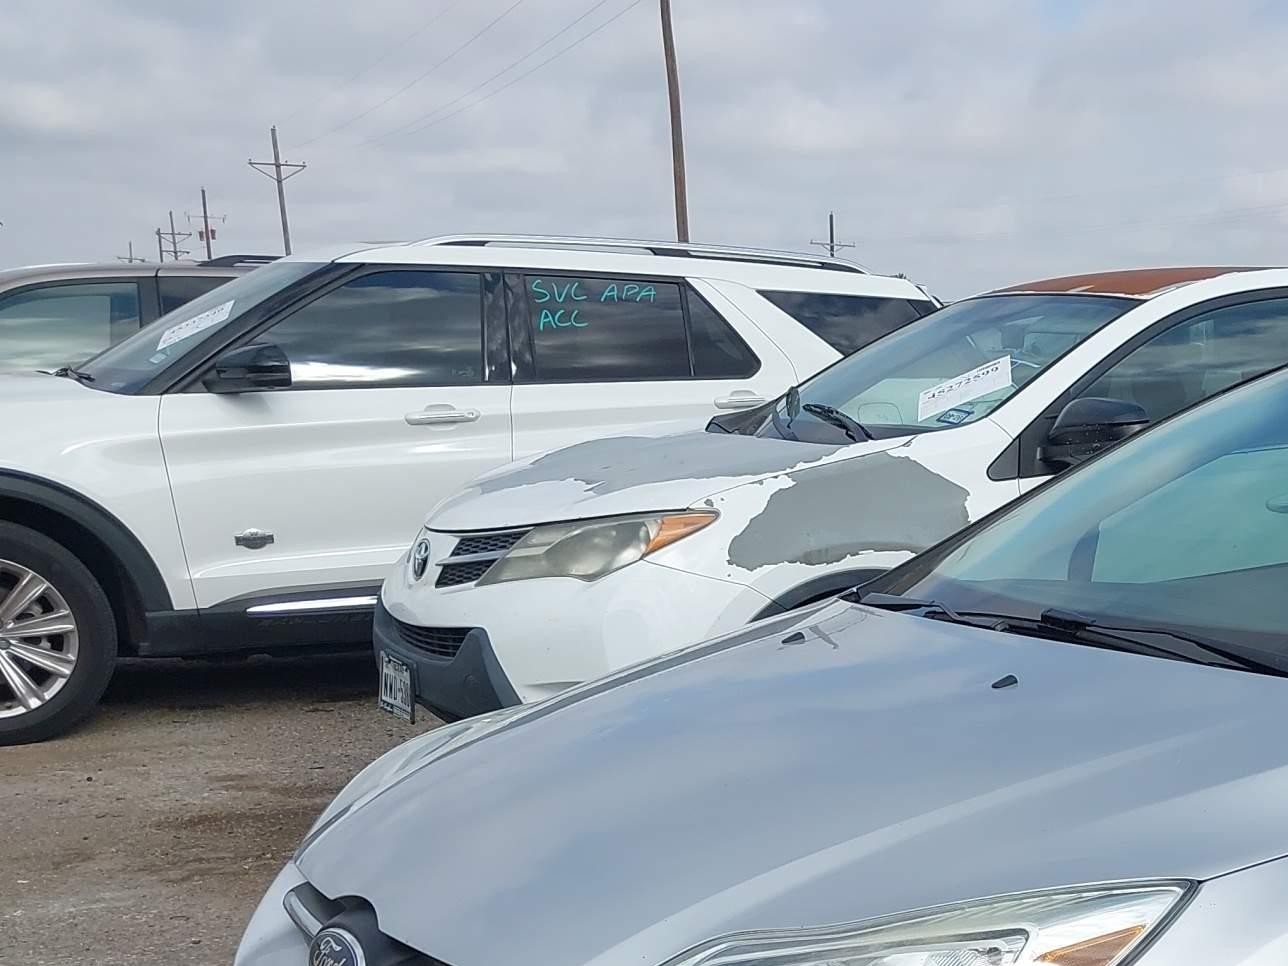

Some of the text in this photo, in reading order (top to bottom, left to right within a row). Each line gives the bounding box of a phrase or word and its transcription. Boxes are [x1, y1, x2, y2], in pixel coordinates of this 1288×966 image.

[532, 279, 656, 303] SVC APA
[539, 309, 588, 331] ACC
